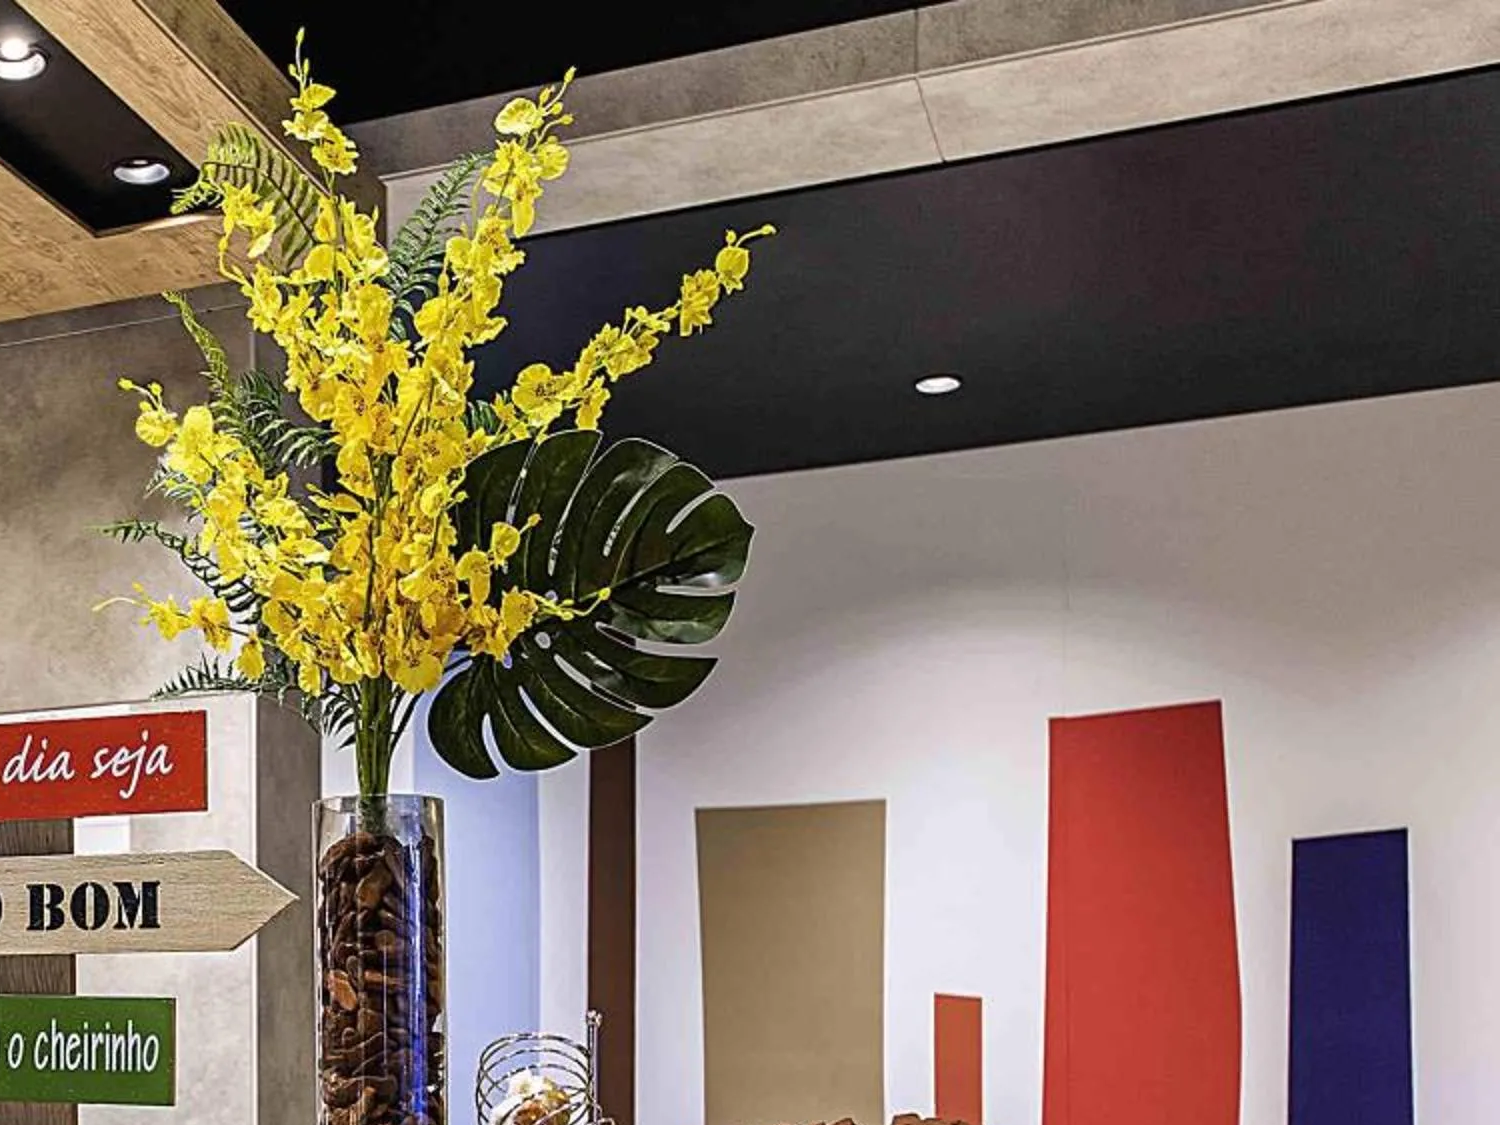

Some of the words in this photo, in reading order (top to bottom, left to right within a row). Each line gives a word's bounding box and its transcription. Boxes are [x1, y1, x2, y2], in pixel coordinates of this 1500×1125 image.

[1, 733, 76, 785] dia
[90, 729, 174, 799] seja
[25, 879, 162, 933] BOM
[6, 1031, 24, 1070] o
[32, 1017, 160, 1073] cheirinho
